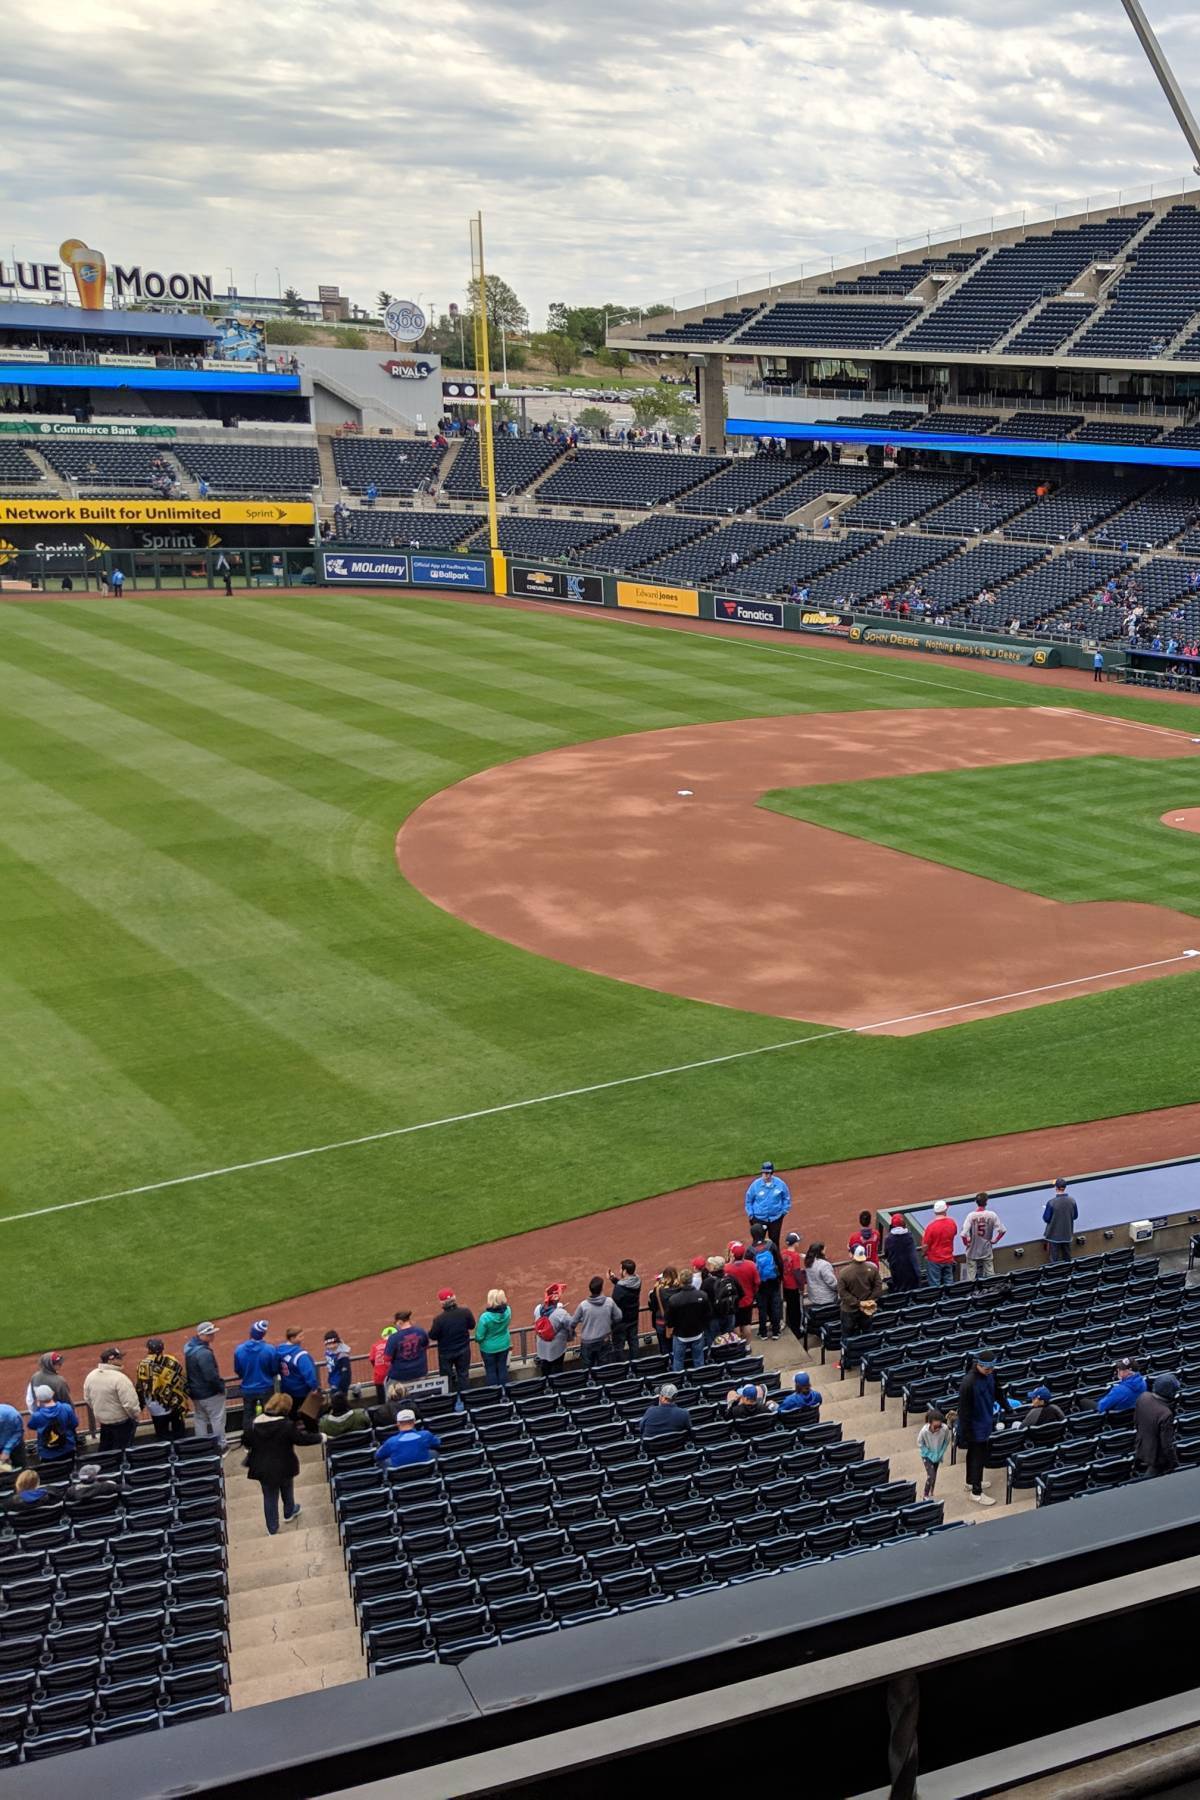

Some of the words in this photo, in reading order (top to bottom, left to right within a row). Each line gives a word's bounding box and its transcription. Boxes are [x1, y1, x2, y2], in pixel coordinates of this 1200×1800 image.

[113, 265, 213, 301] MOON
[387, 308, 426, 333] 360
[391, 366, 428, 377] RIVALS
[53, 424, 109, 435] Commerce
[111, 426, 137, 435] Bank
[5, 507, 76, 519] Network
[80, 507, 116, 519] Built
[119, 507, 142, 519] for
[146, 508, 221, 519] Unlimited
[246, 510, 274, 519] Sprint
[142, 533, 196, 549] Sprint
[35, 542, 86, 561] Sprint
[351, 562, 405, 575] MOLottery
[439, 571, 469, 580] Ballpark
[737, 607, 774, 622] Fanatics
[864, 632, 888, 643] JOHN
[890, 634, 919, 647] DEERE
[977, 1224, 985, 1237] 5
